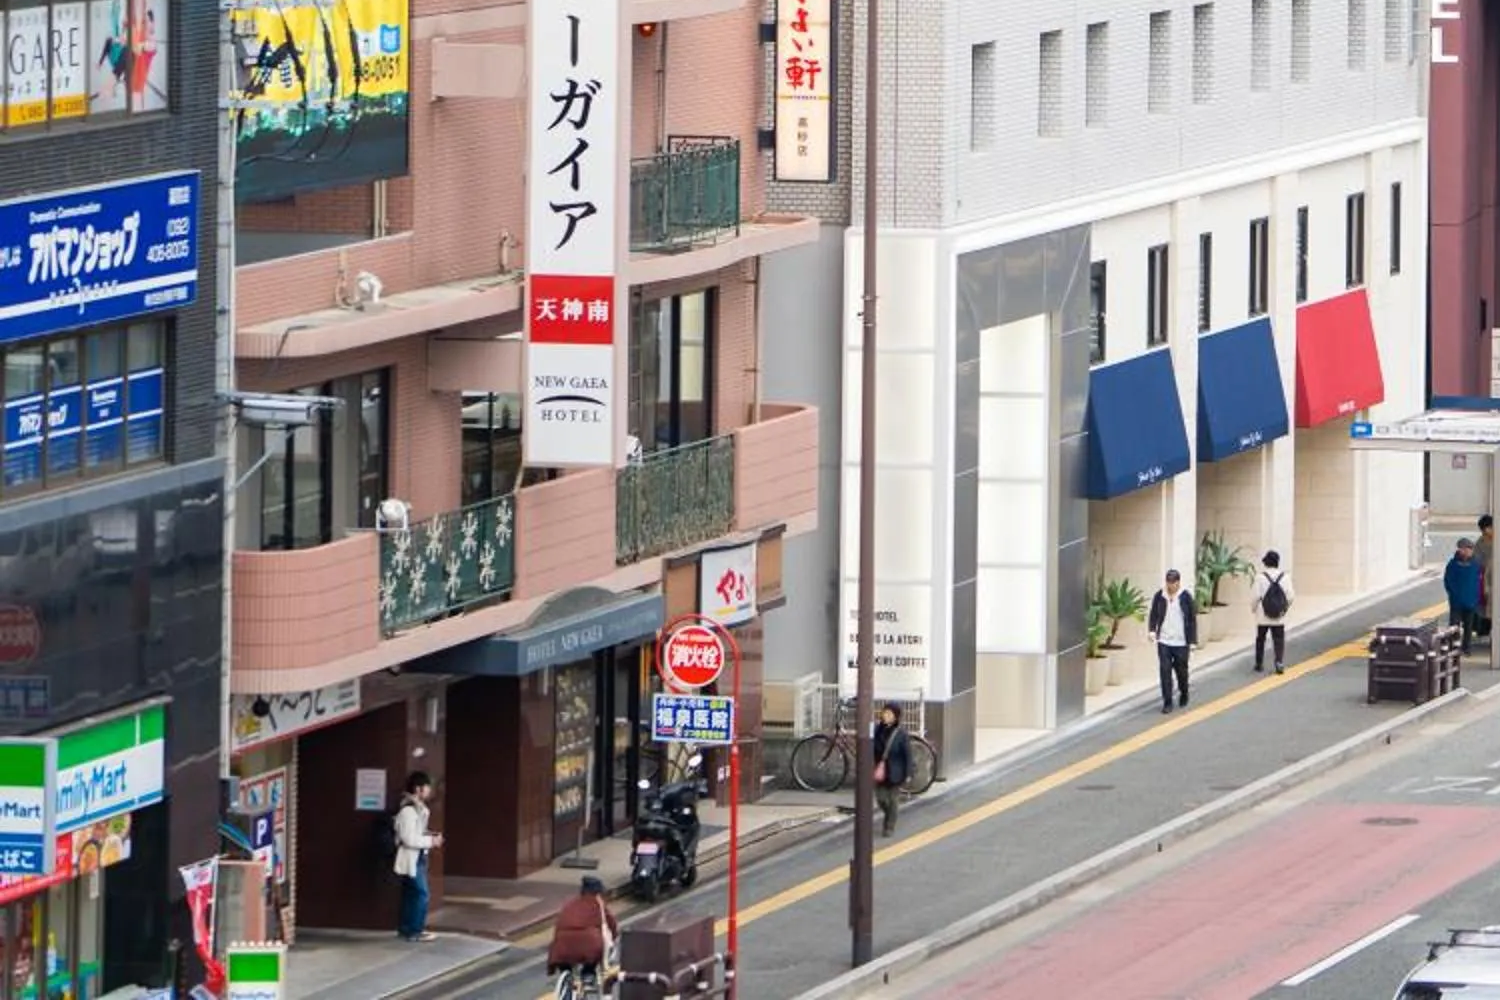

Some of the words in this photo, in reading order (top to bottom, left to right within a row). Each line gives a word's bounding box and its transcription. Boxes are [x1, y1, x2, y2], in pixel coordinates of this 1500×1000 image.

[28, 211, 141, 285] アパマンショップ
[535, 297, 609, 322] 天神南
[534, 376, 567, 389] NEW
[569, 377, 608, 389] GAEA
[541, 409, 601, 422] HOTEL
[672, 643, 719, 670] 消火栓
